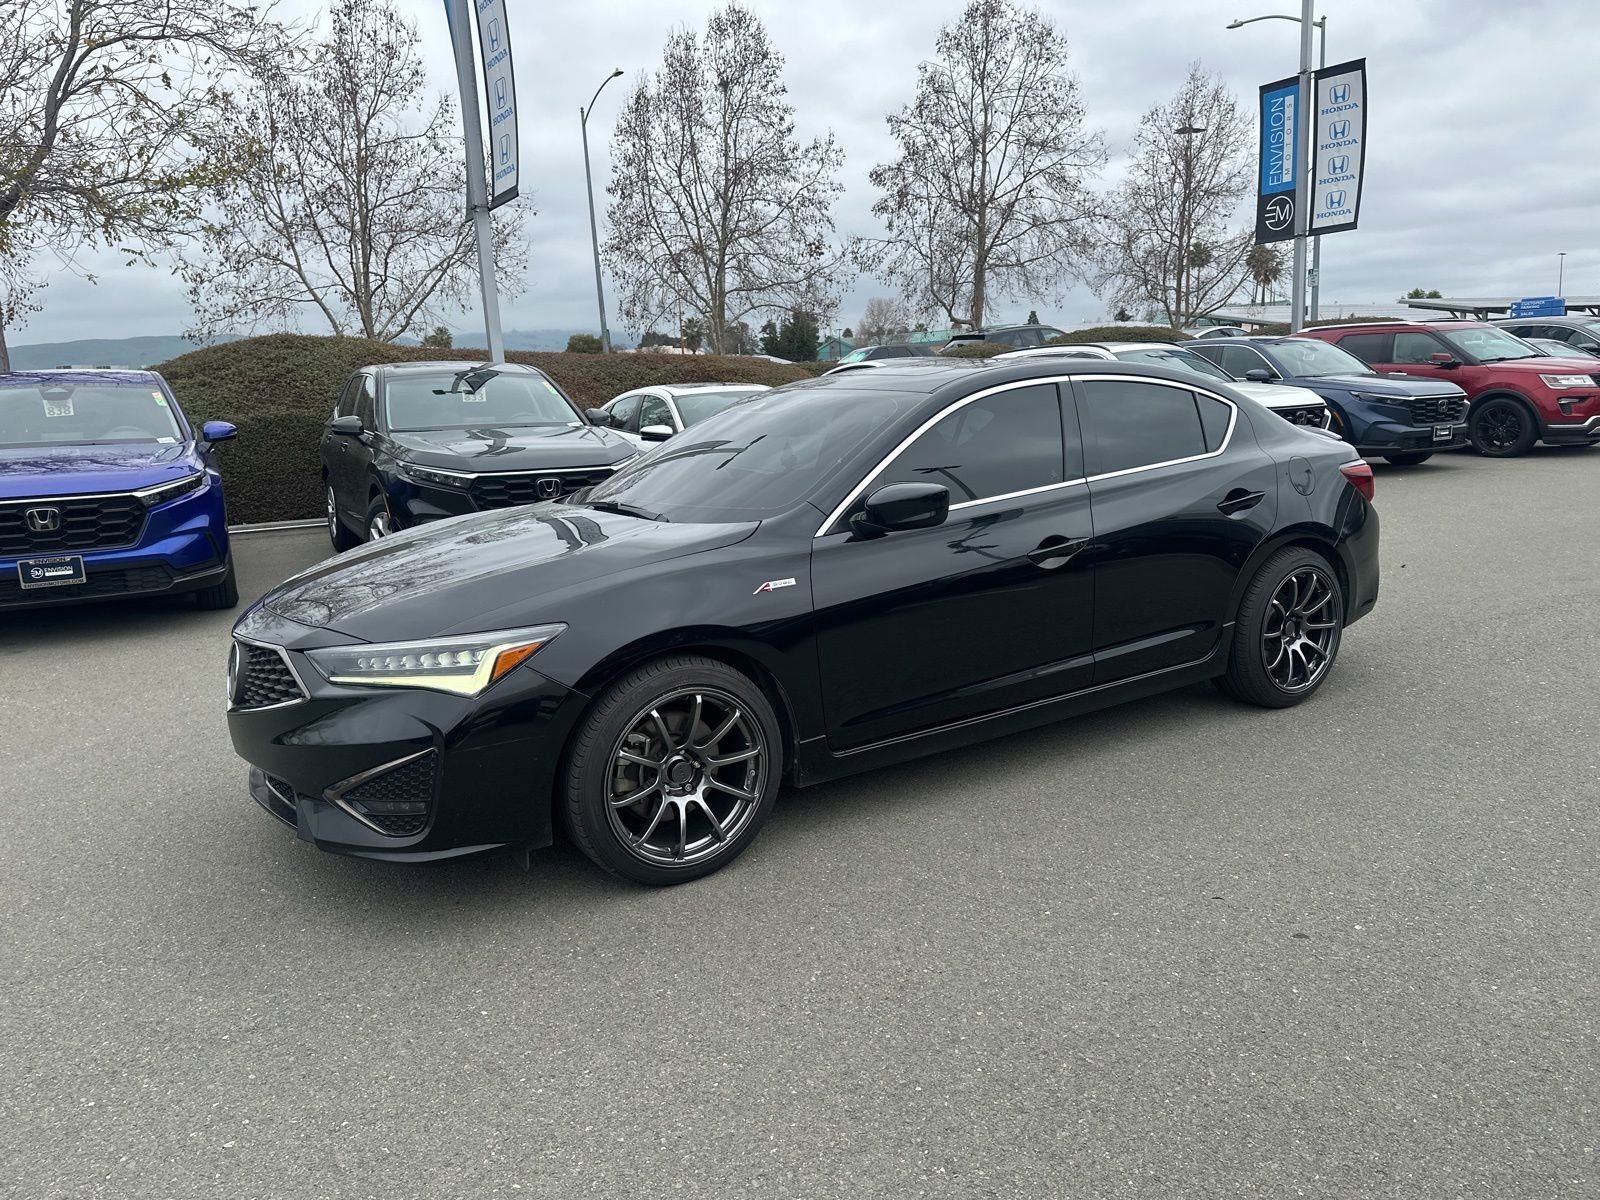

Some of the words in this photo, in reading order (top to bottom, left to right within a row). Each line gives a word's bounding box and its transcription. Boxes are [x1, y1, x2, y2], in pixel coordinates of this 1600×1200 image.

[487, 48, 508, 71] HONDA
[492, 106, 514, 127] HONDA
[1321, 102, 1360, 116] HONDA
[1269, 97, 1284, 186] ENVISION
[1285, 103, 1293, 175] MOTORS
[1320, 138, 1359, 151] HONDA
[495, 163, 516, 182] HONDA
[1318, 174, 1356, 185] HONDA
[1316, 208, 1352, 219] HONDA
[47, 406, 72, 416] 838
